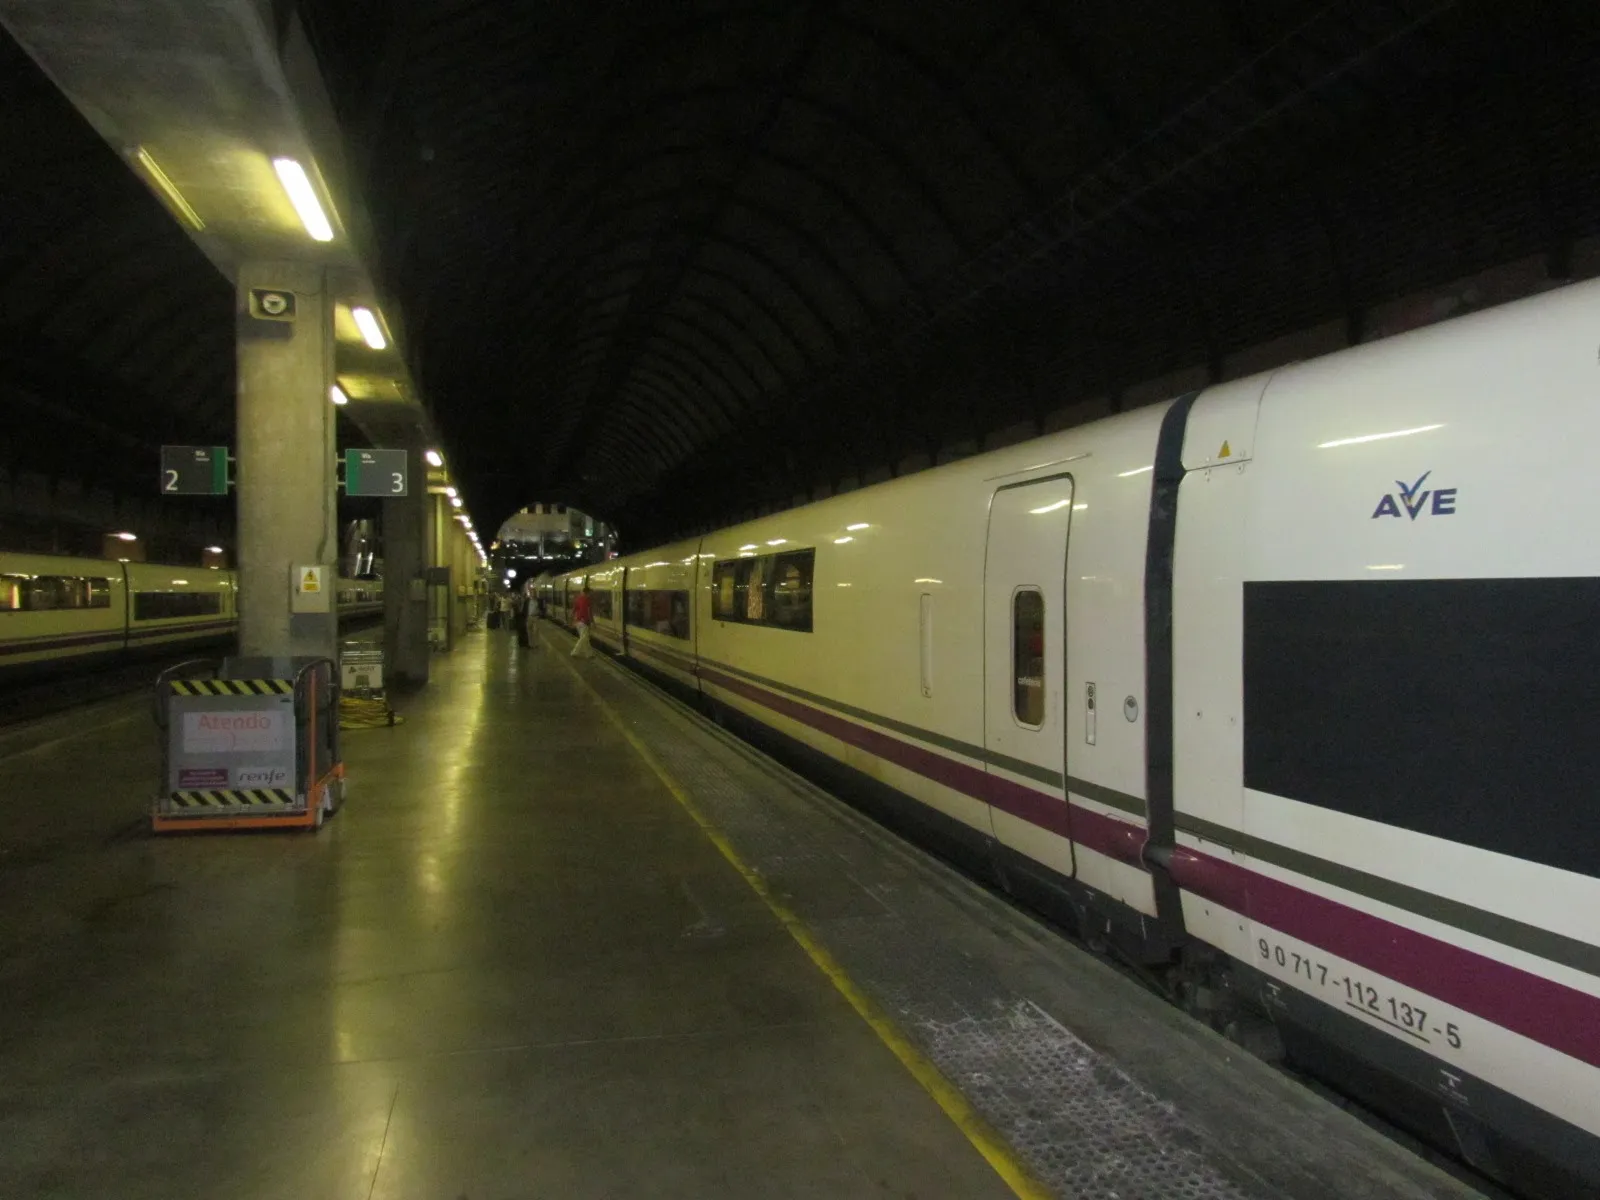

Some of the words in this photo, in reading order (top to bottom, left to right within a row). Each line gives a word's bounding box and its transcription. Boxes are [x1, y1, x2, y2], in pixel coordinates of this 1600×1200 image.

[165, 469, 179, 491] 2
[391, 472, 404, 493] 3
[1371, 470, 1458, 521] AVE
[197, 713, 272, 731] Atendo
[239, 768, 286, 785] renfe
